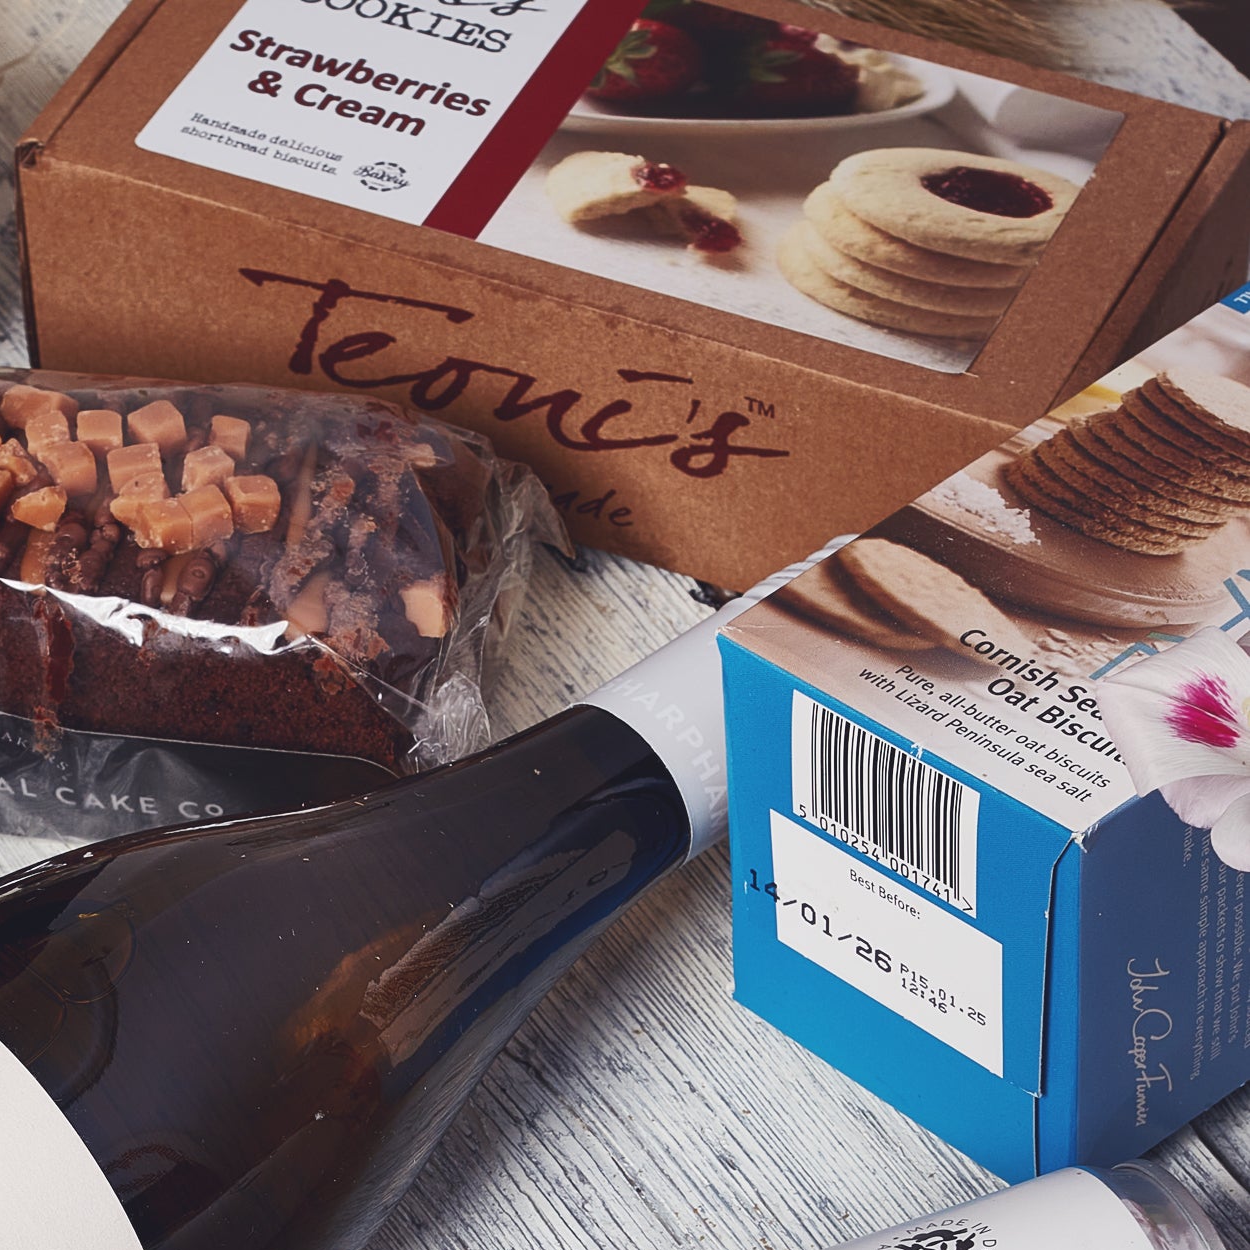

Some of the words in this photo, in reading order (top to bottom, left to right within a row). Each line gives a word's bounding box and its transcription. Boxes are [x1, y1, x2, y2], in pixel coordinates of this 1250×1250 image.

[229, 29, 491, 118] Strawberries
[247, 70, 279, 98] &
[293, 83, 427, 137] Cream
[180, 126, 269, 156] shortbread
[273, 148, 338, 176] biscuits
[190, 112, 267, 141] Handmade
[268, 134, 344, 162] delicious
[959, 629, 1058, 691] Cornish
[987, 678, 1040, 713] Oat
[859, 667, 897, 694] with
[895, 688, 944, 723] Lizard
[944, 718, 1022, 766] Peninsula
[1024, 763, 1056, 785] sea
[1056, 775, 1093, 803] salt
[895, 665, 935, 696] Pure,
[940, 690, 1017, 737] all-butter
[1015, 731, 1047, 754] oat
[1044, 748, 1111, 789] biscuits
[54, 786, 159, 816] CAKE
[799, 804, 807, 818] 5
[819, 816, 880, 862] 010254
[889, 857, 950, 903] 001741
[849, 869, 876, 893] Best
[878, 888, 921, 920] Before:
[1200, 858, 1210, 894] same
[1235, 872, 1245, 899] ever
[749, 868, 892, 973] 14/01/26
[1196, 895, 1210, 938] simple
[1215, 887, 1228, 937] packets
[1233, 902, 1245, 960] possible.
[1216, 938, 1226, 952] to
[1196, 940, 1208, 999] approach
[1214, 954, 1226, 988] show
[1232, 959, 1244, 982] We
[900, 962, 987, 1026] P15.01.25
[900, 978, 948, 1015] 12:46
[1197, 999, 1207, 1014] in
[1213, 988, 1225, 1014] that
[1230, 983, 1241, 1006] put
[1213, 1016, 1221, 1035] we
[1227, 1005, 1241, 1044] John's
[1190, 1015, 1205, 1081] everything
[1210, 1036, 1221, 1061] still
[906, 1218, 969, 1235] MADE
[970, 1222, 992, 1235] IN
